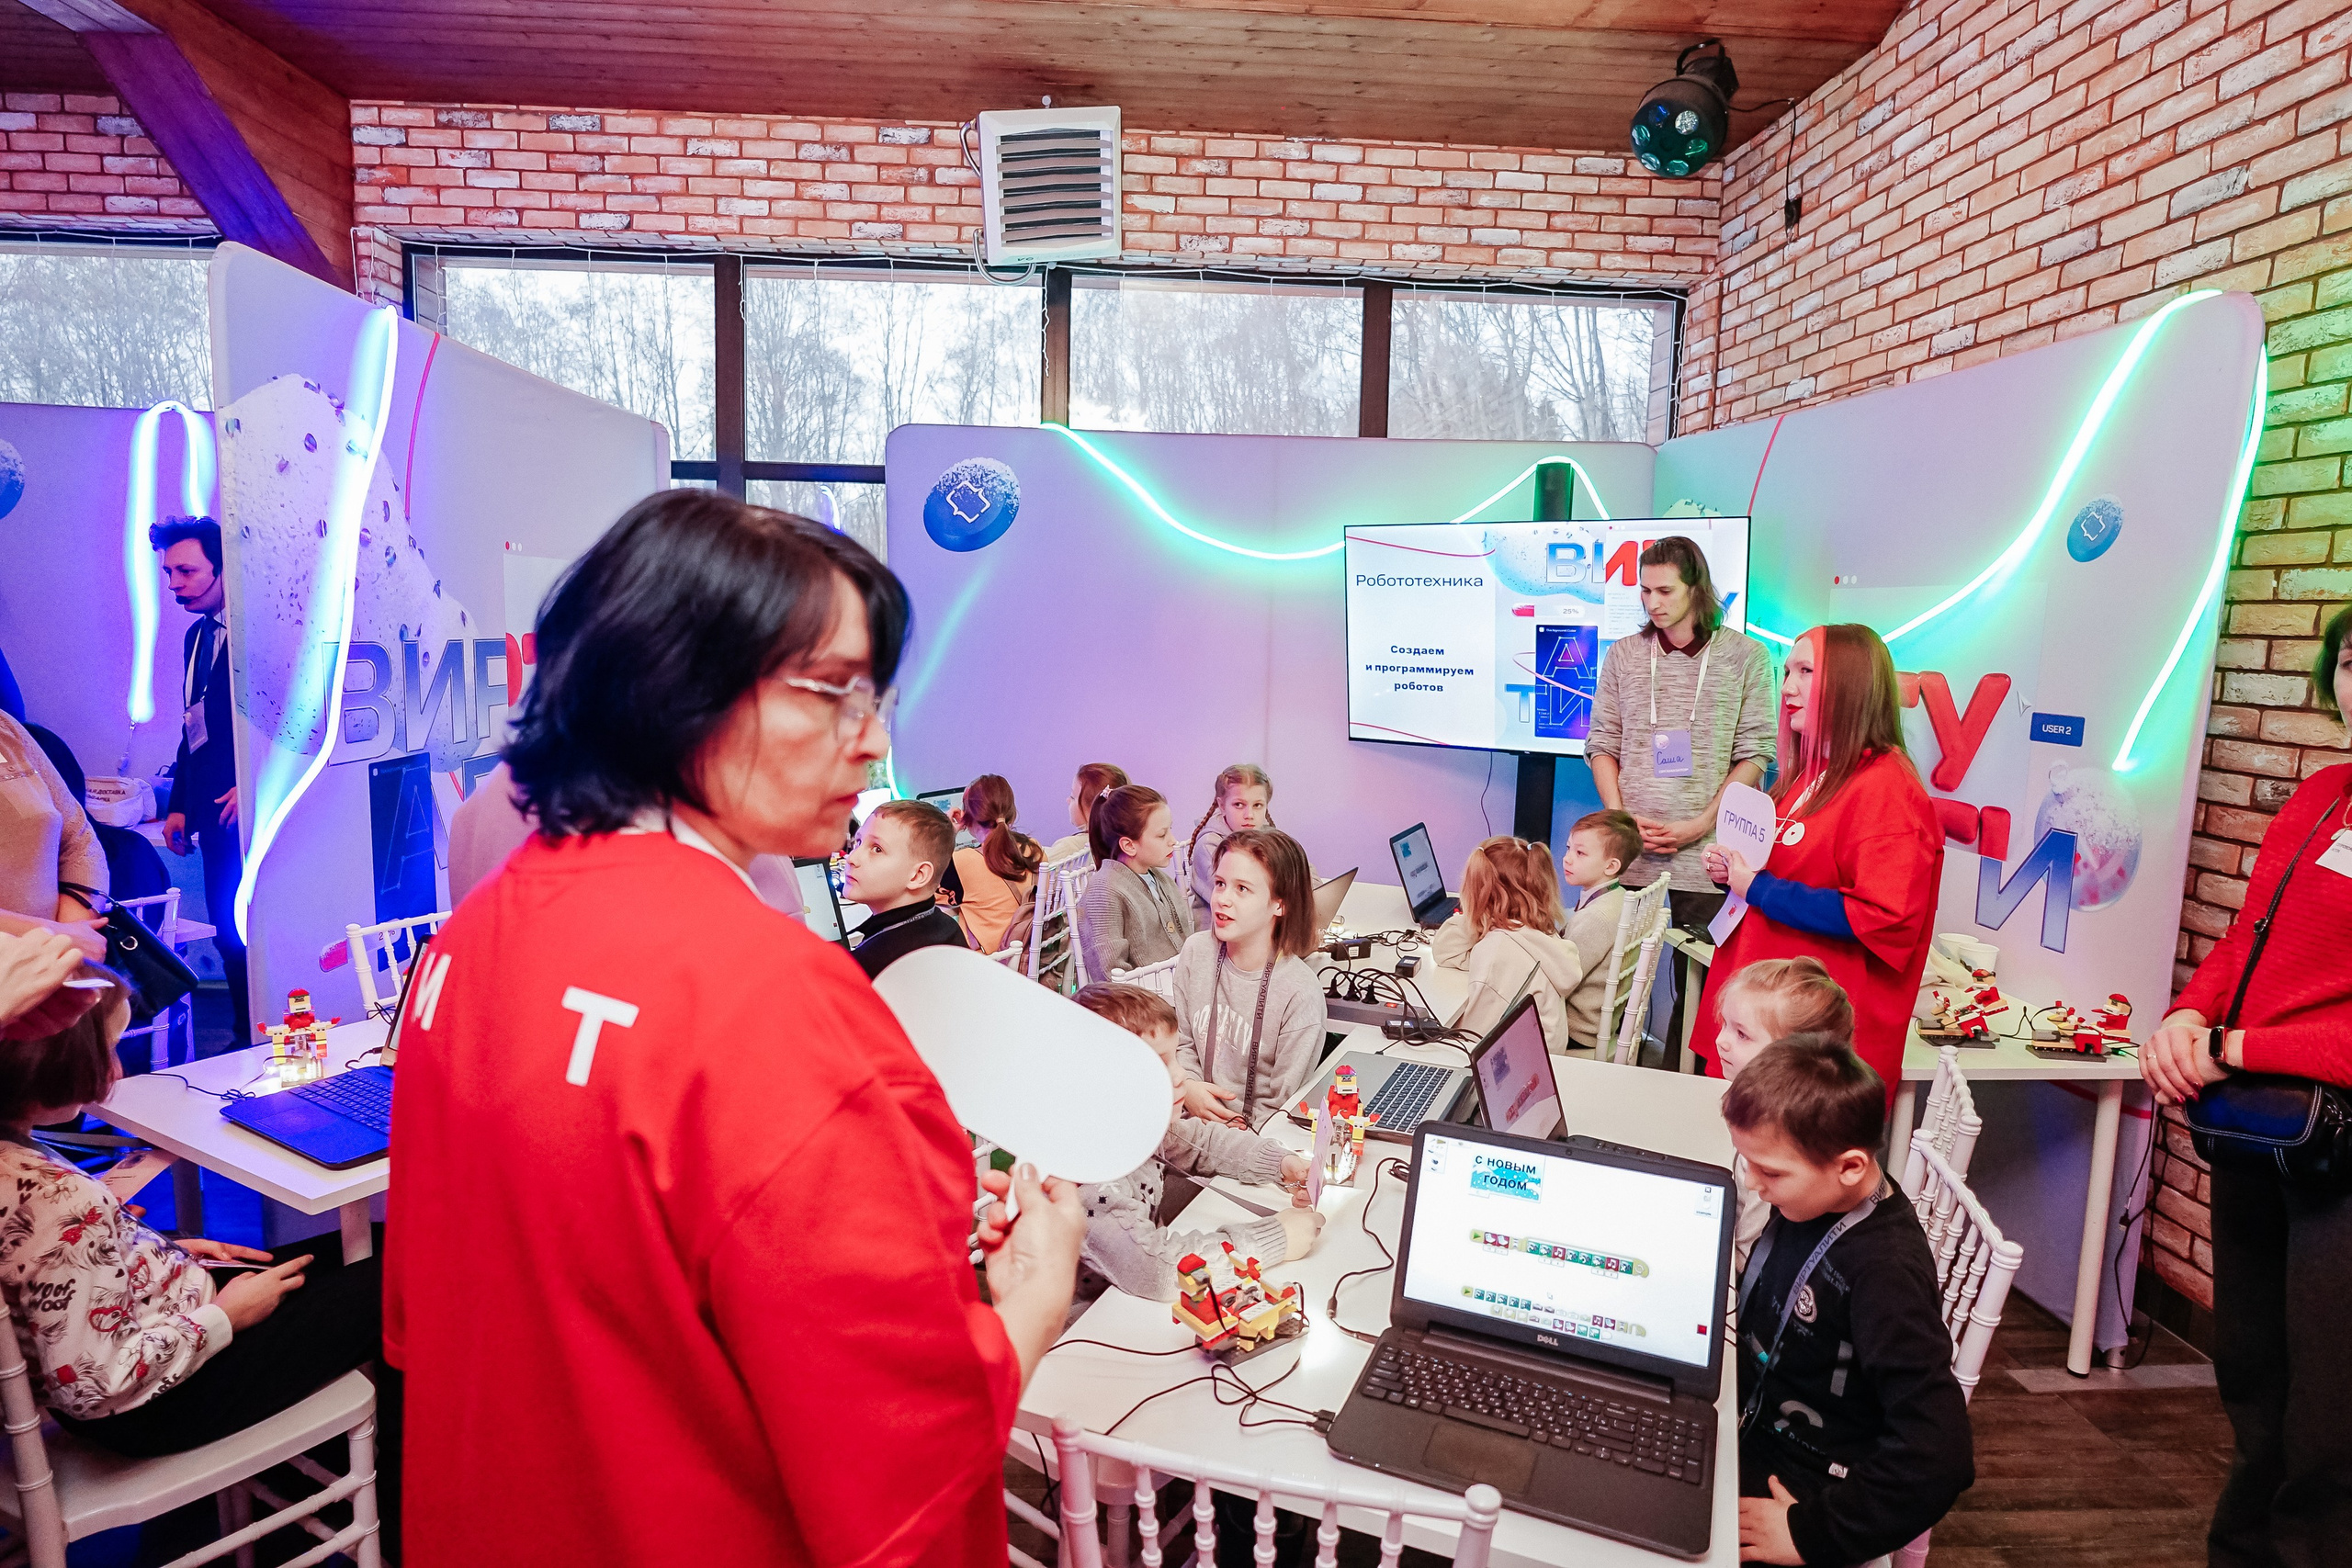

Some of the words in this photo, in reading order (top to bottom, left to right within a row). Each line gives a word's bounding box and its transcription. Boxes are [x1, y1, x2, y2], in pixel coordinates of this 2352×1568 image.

[1356, 573, 1484, 587] Робототехника
[1390, 645, 1444, 656] Создаем
[1374, 664, 1475, 677] программируем
[1394, 682, 1444, 692] роботов
[2041, 724, 2065, 734] USER
[2065, 726, 2072, 735] 2
[1657, 750, 1684, 765] Саша
[1724, 809, 1758, 840] ГРУППА
[1758, 828, 1766, 842] 5
[1256, 962, 1274, 1021] ВИРТУАЛИТИ
[1245, 1041, 1259, 1100] ВИРТУАЛИТИ
[1475, 1155, 1483, 1165] С
[1487, 1157, 1536, 1175] НОВЫМ
[1483, 1174, 1528, 1190] ГОДОМ
[1792, 1221, 1847, 1296] ВИРТУАЛИТИ
[1536, 1334, 1559, 1347] DELL
